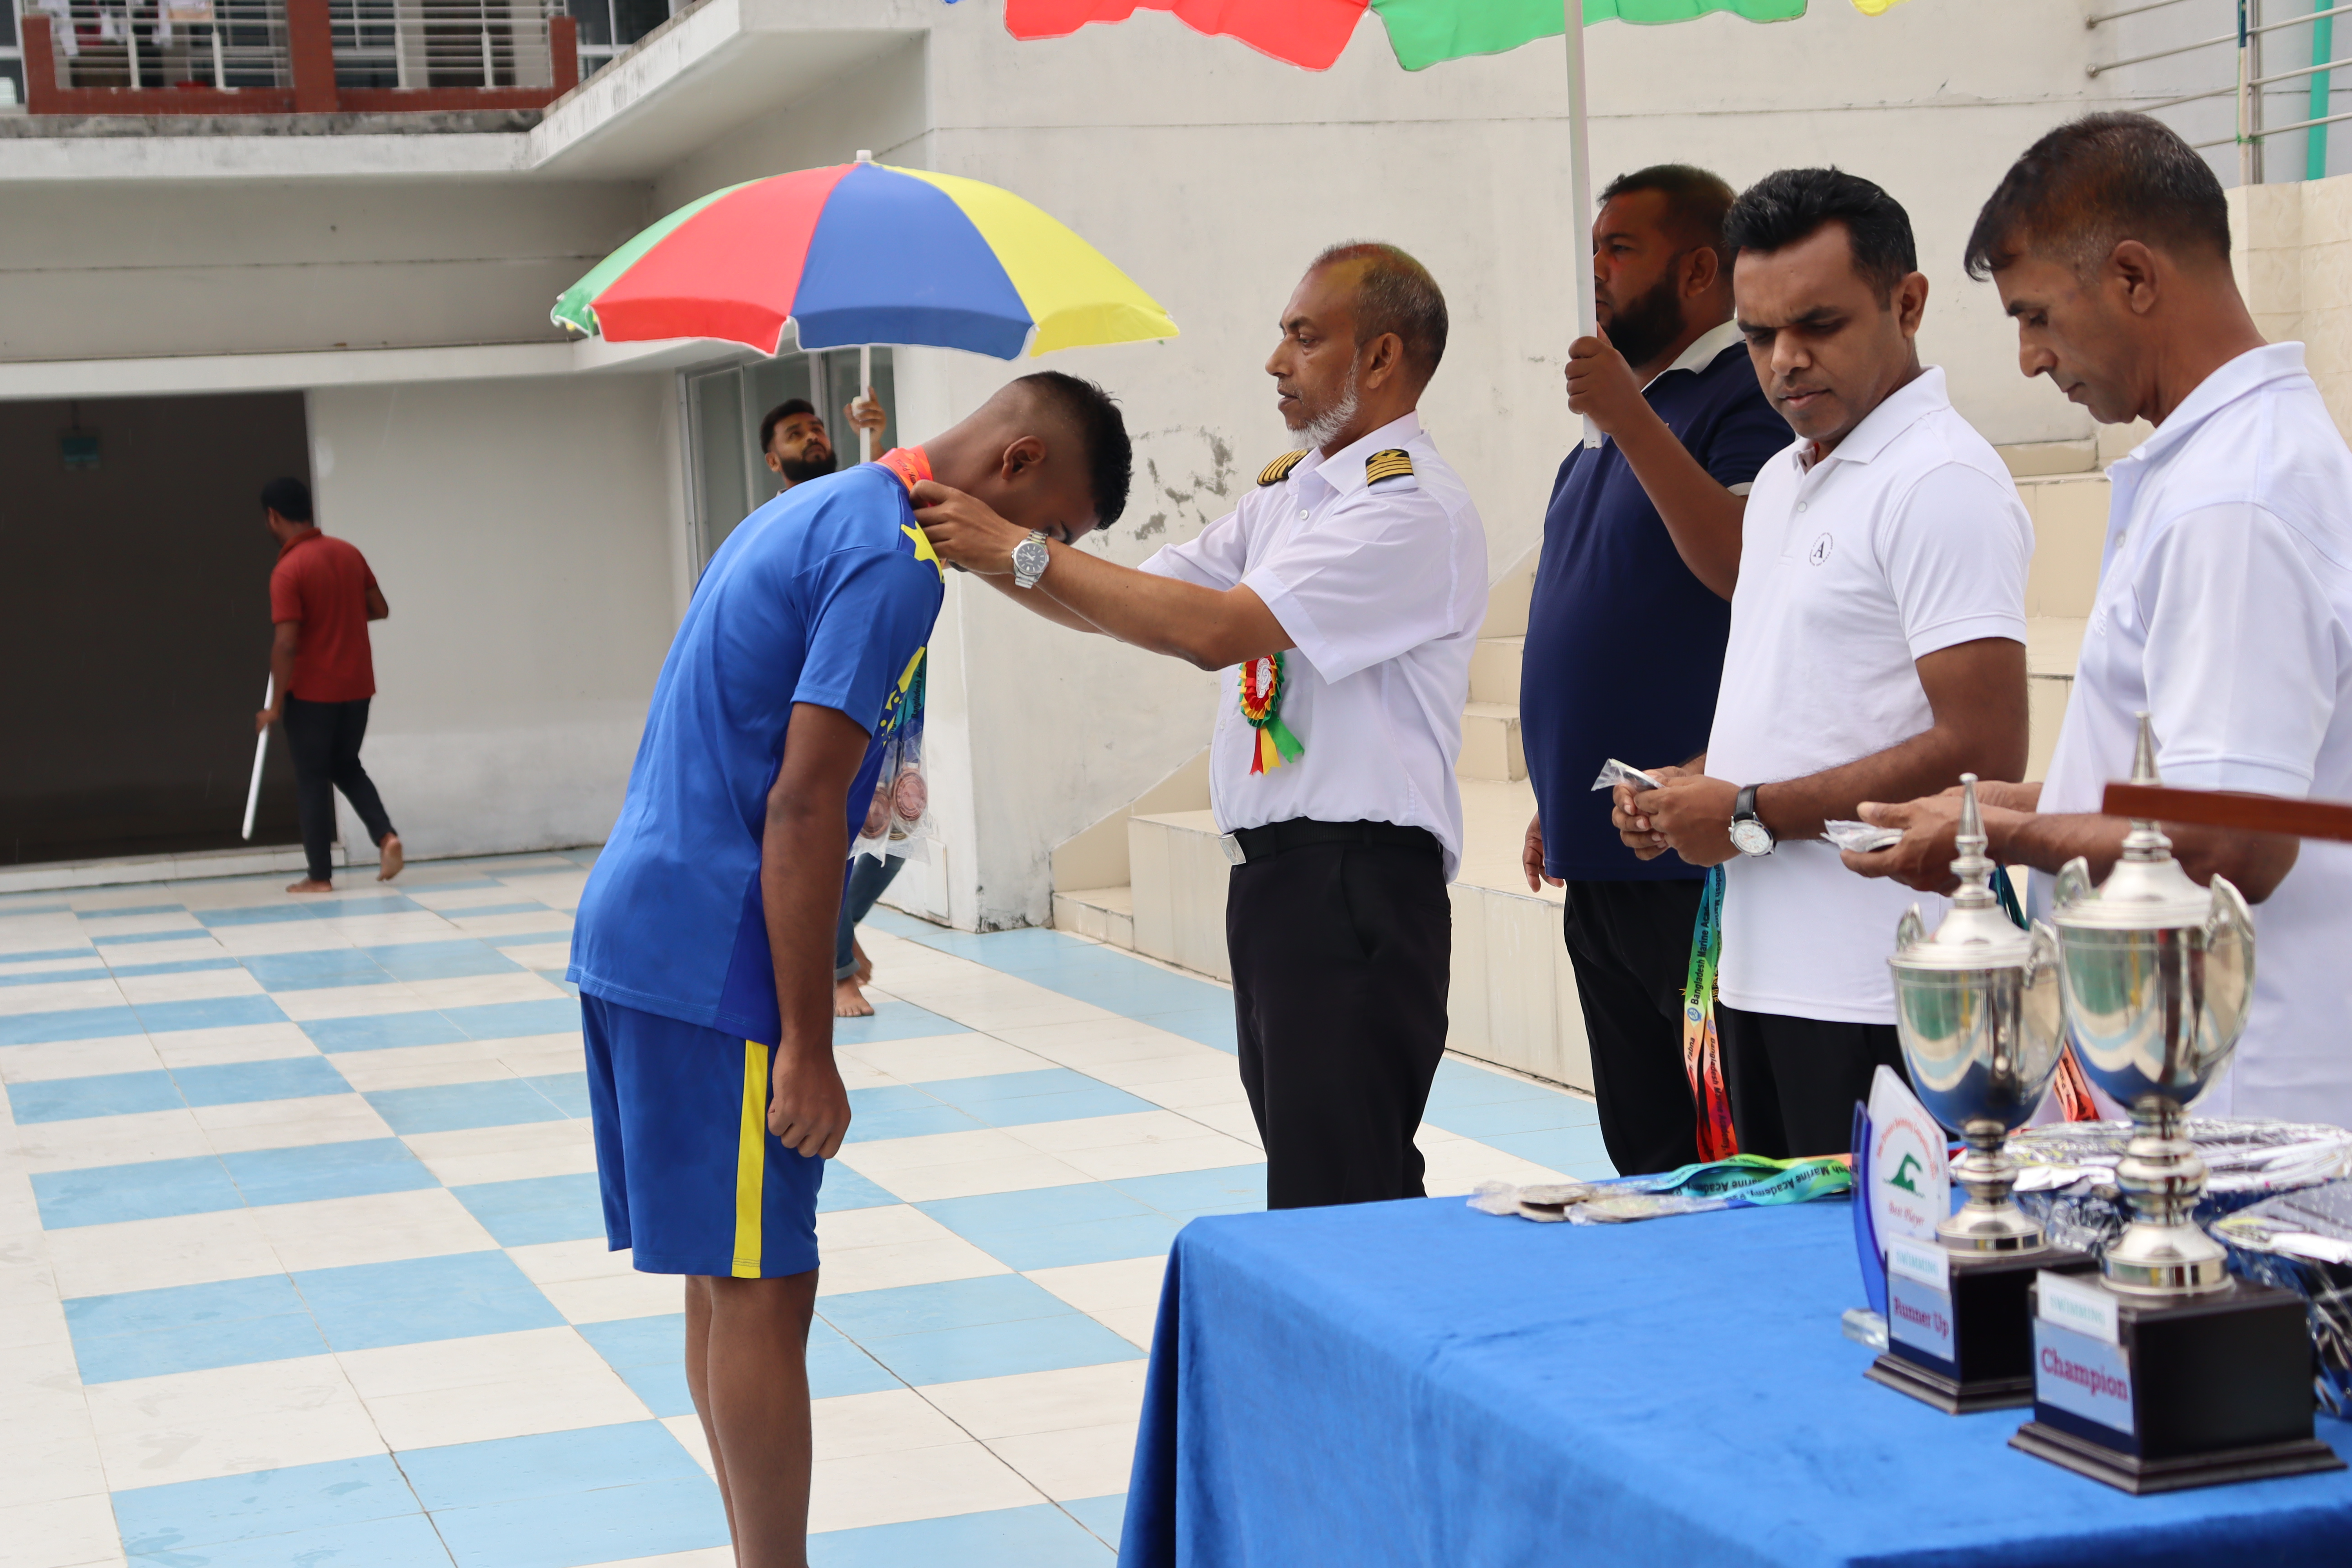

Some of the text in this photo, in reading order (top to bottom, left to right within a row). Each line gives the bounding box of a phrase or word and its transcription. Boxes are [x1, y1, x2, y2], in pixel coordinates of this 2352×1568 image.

[1813, 541, 1824, 558] A
[911, 680, 921, 719] Bangladesh
[1714, 864, 1722, 897] gladesh
[1697, 930, 1709, 958] Marine
[1691, 959, 1705, 1005] Bangladesh
[1710, 1038, 1719, 1085] Bangladesh
[1732, 1178, 1761, 1188] arine
[1796, 1166, 1830, 1183] Marine
[1889, 1200, 1925, 1228] Best Player
[1896, 1249, 1938, 1276] SWIMMING
[1893, 1295, 1949, 1339] Runner Up
[2050, 1296, 2105, 1324] SWIMMING
[2042, 1347, 2128, 1401] Champion
